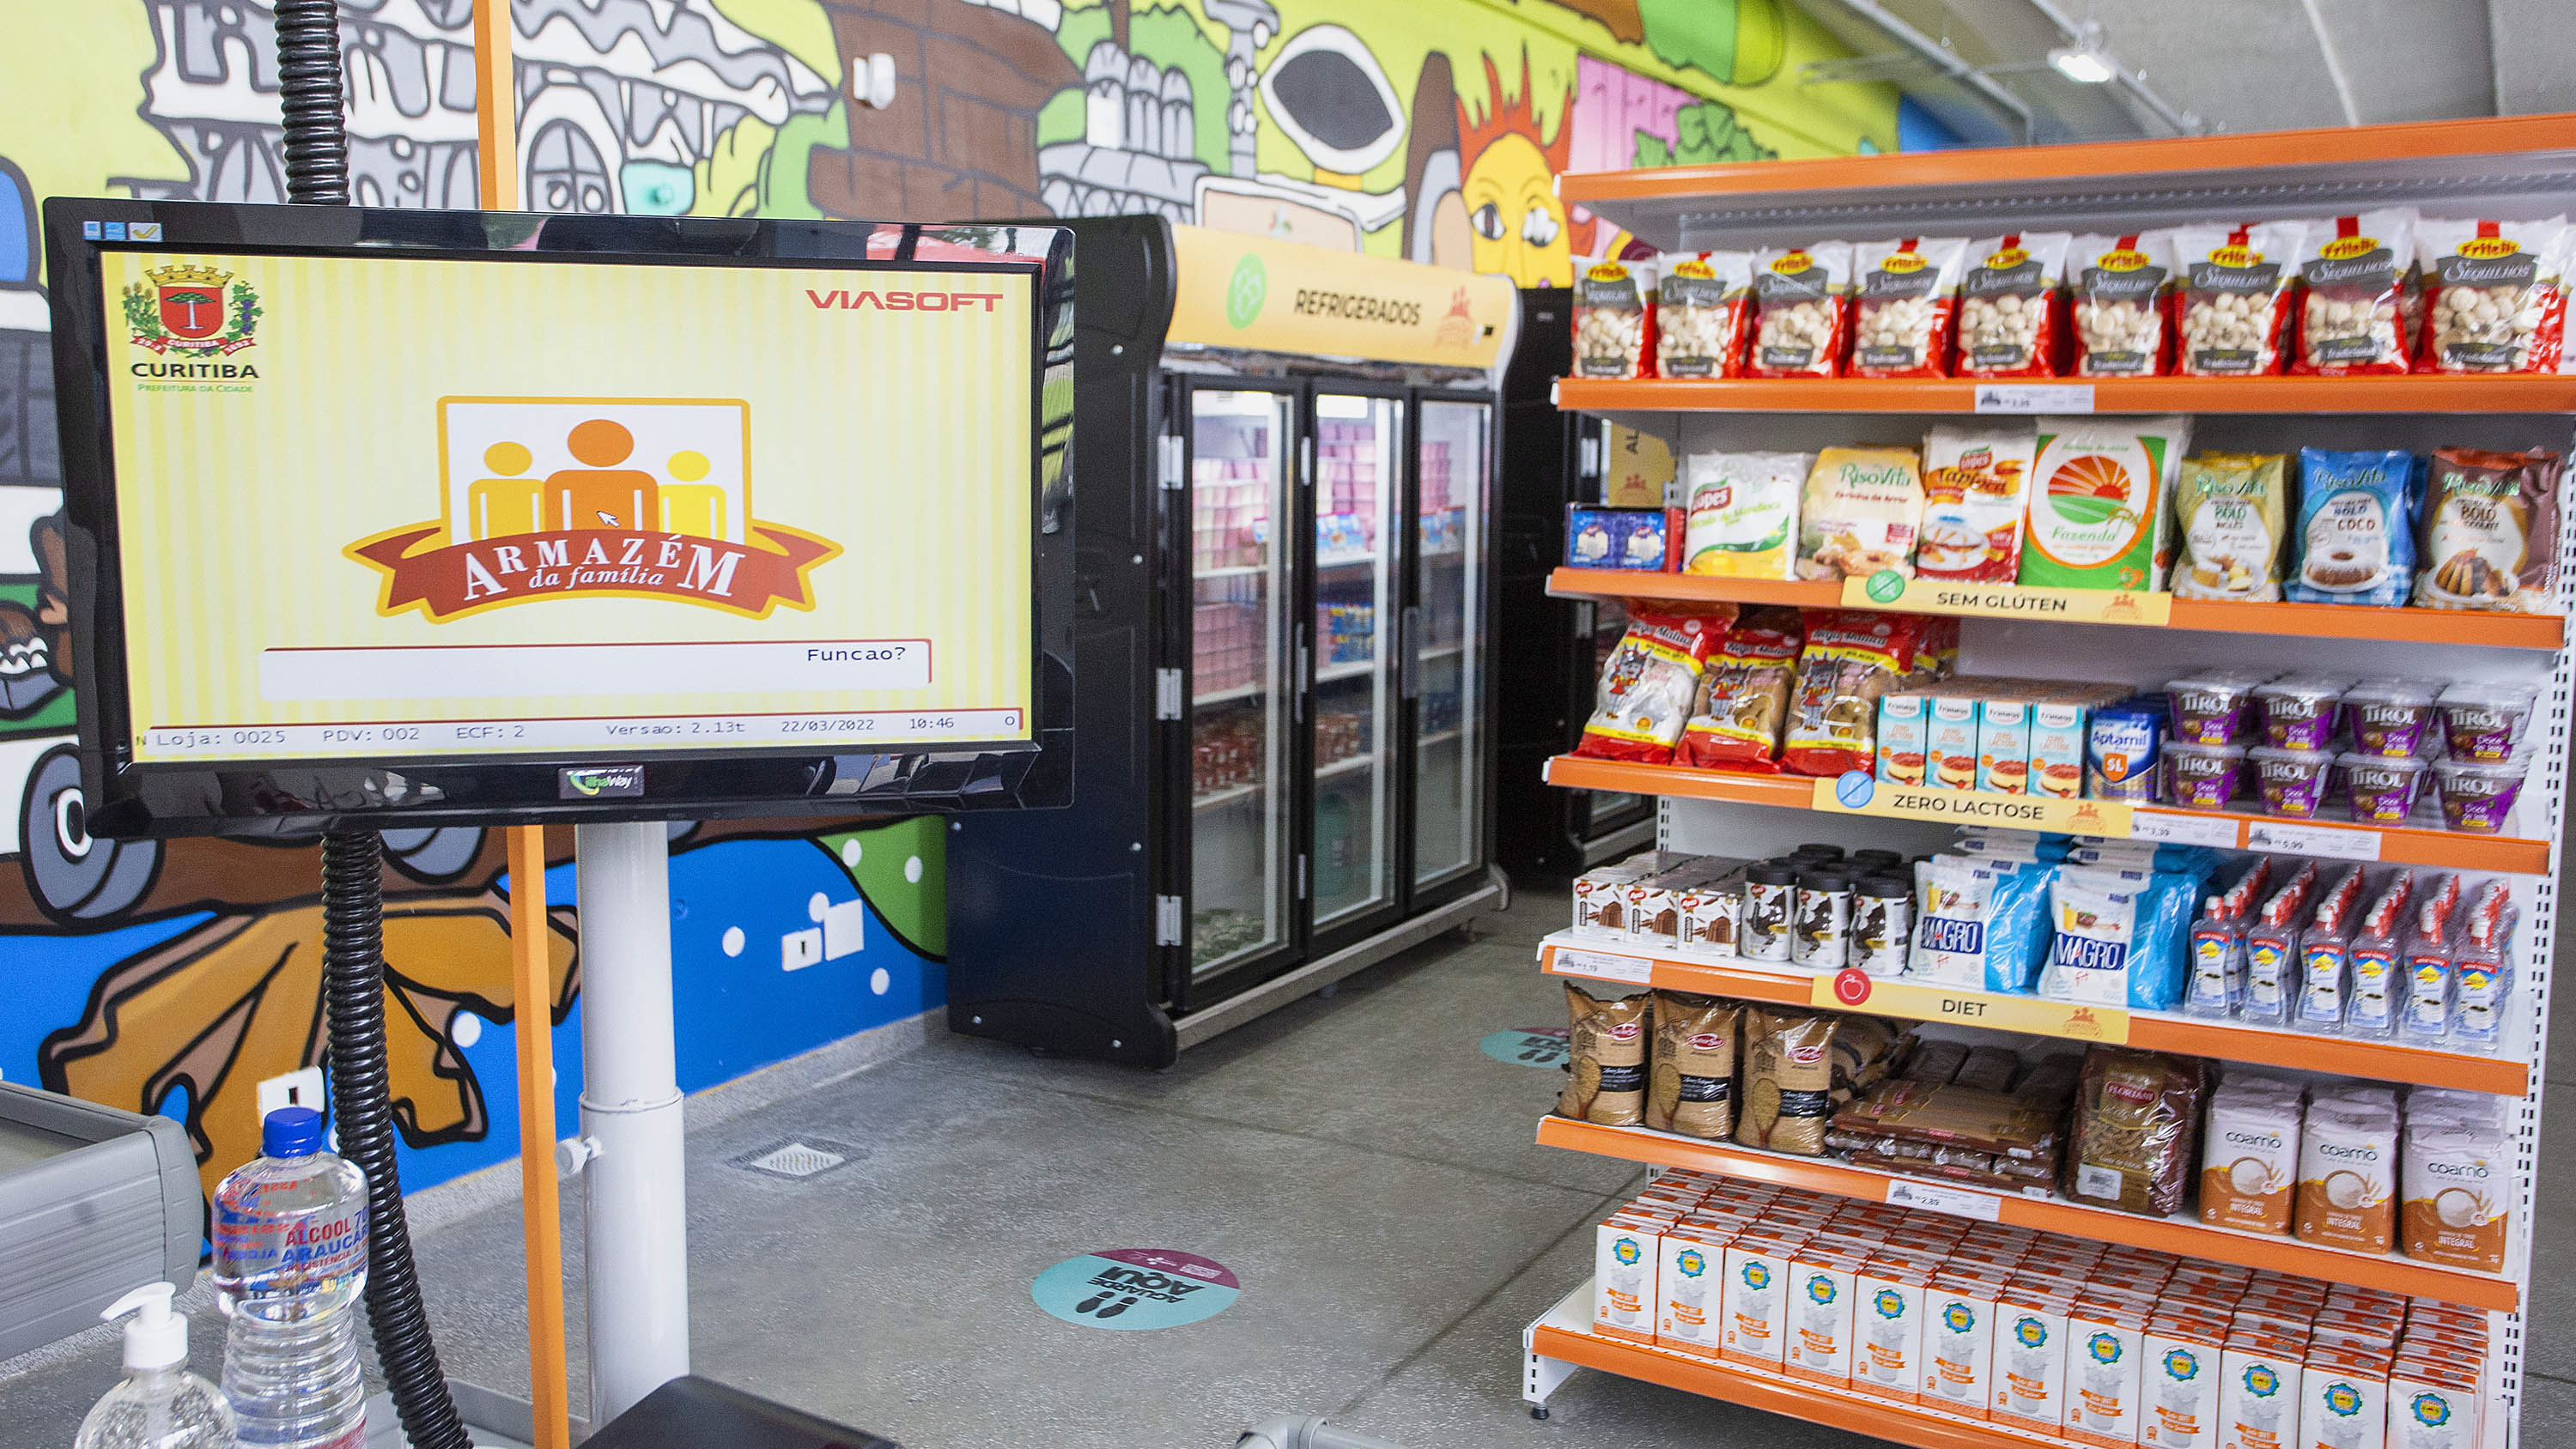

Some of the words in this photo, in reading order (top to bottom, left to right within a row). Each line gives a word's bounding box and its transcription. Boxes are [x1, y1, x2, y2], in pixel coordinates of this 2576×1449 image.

[805, 289, 1004, 312] VIASOFT
[1294, 288, 1424, 326] REFRIGERADOS
[131, 363, 259, 379] CURITIBA
[1839, 462, 1911, 488] RisoVita
[2337, 518, 2376, 530] COCO
[2461, 506, 2497, 522] BOLO
[2052, 524, 2117, 542] Fazenda
[462, 533, 746, 601] ARMAZÉM
[528, 566, 560, 589] da
[565, 566, 665, 591] família
[1936, 591, 1977, 606] SEM
[1984, 592, 2068, 612] GLÚTEN
[807, 646, 907, 663] Funcao?
[2181, 692, 2233, 714] TIROL
[2265, 696, 2318, 718] TIROL
[2363, 704, 2417, 724] TIROL
[2449, 708, 2508, 730] TIROL
[157, 731, 222, 748] Loja:
[234, 729, 286, 744] 0025
[323, 728, 373, 742] PDV:
[382, 727, 421, 741] 002
[457, 725, 504, 740] ECF:
[513, 724, 526, 738] 2
[606, 723, 683, 736] Versao:
[690, 722, 745, 734] 2.13t
[781, 718, 875, 733] 22/03/2022
[908, 717, 955, 730] 10:46
[2093, 731, 2147, 745] Aptamil
[2106, 757, 2124, 773] SL
[2175, 753, 2226, 775] TIROL
[2258, 759, 2310, 780] TIROL
[2349, 766, 2405, 788] TIROL
[2445, 774, 2498, 796] TIROL
[1893, 794, 1947, 811] ZERO
[1953, 799, 2044, 820] LACTOSE
[1923, 919, 1978, 953] MAGRO
[2056, 933, 2121, 969] MAGRO
[1941, 998, 1989, 1016] DIET
[2226, 1131, 2282, 1149] coamo
[2319, 1143, 2378, 1161] coamo
[2427, 1162, 2489, 1179] coamo
[2229, 1203, 2264, 1216] INTEGRAL
[2326, 1216, 2361, 1230] INTEGRAL
[2439, 1235, 2475, 1249] INTEGRAL
[1086, 1276, 1187, 1304] AGUARDE
[1093, 1265, 1206, 1296] AQUI
